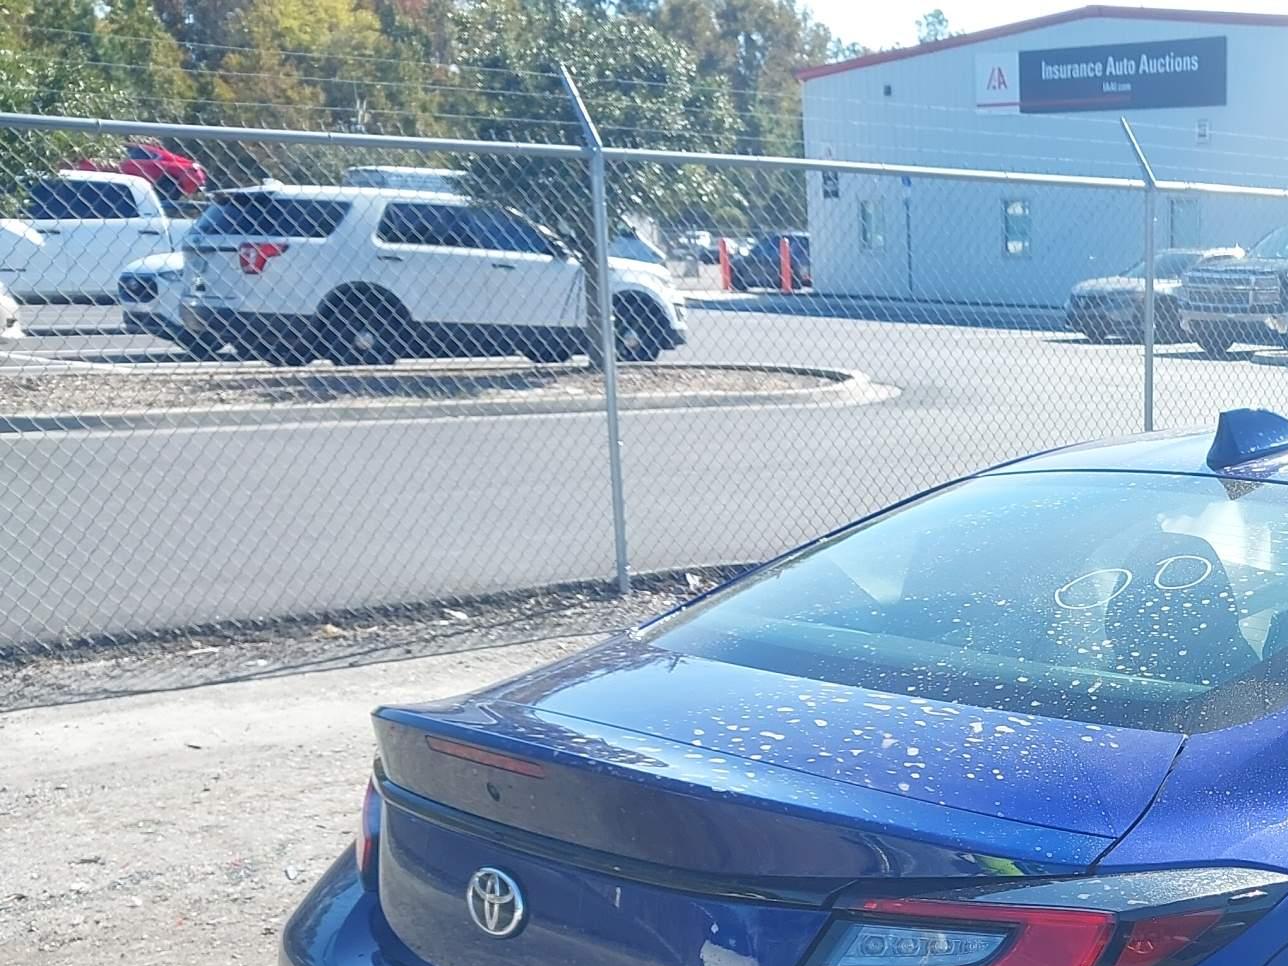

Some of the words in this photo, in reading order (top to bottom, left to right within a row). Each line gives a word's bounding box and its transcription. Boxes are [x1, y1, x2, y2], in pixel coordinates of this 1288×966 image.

[1041, 60, 1102, 80] Insurance
[1106, 56, 1135, 76] Auto
[1139, 52, 1199, 74] Auctions
